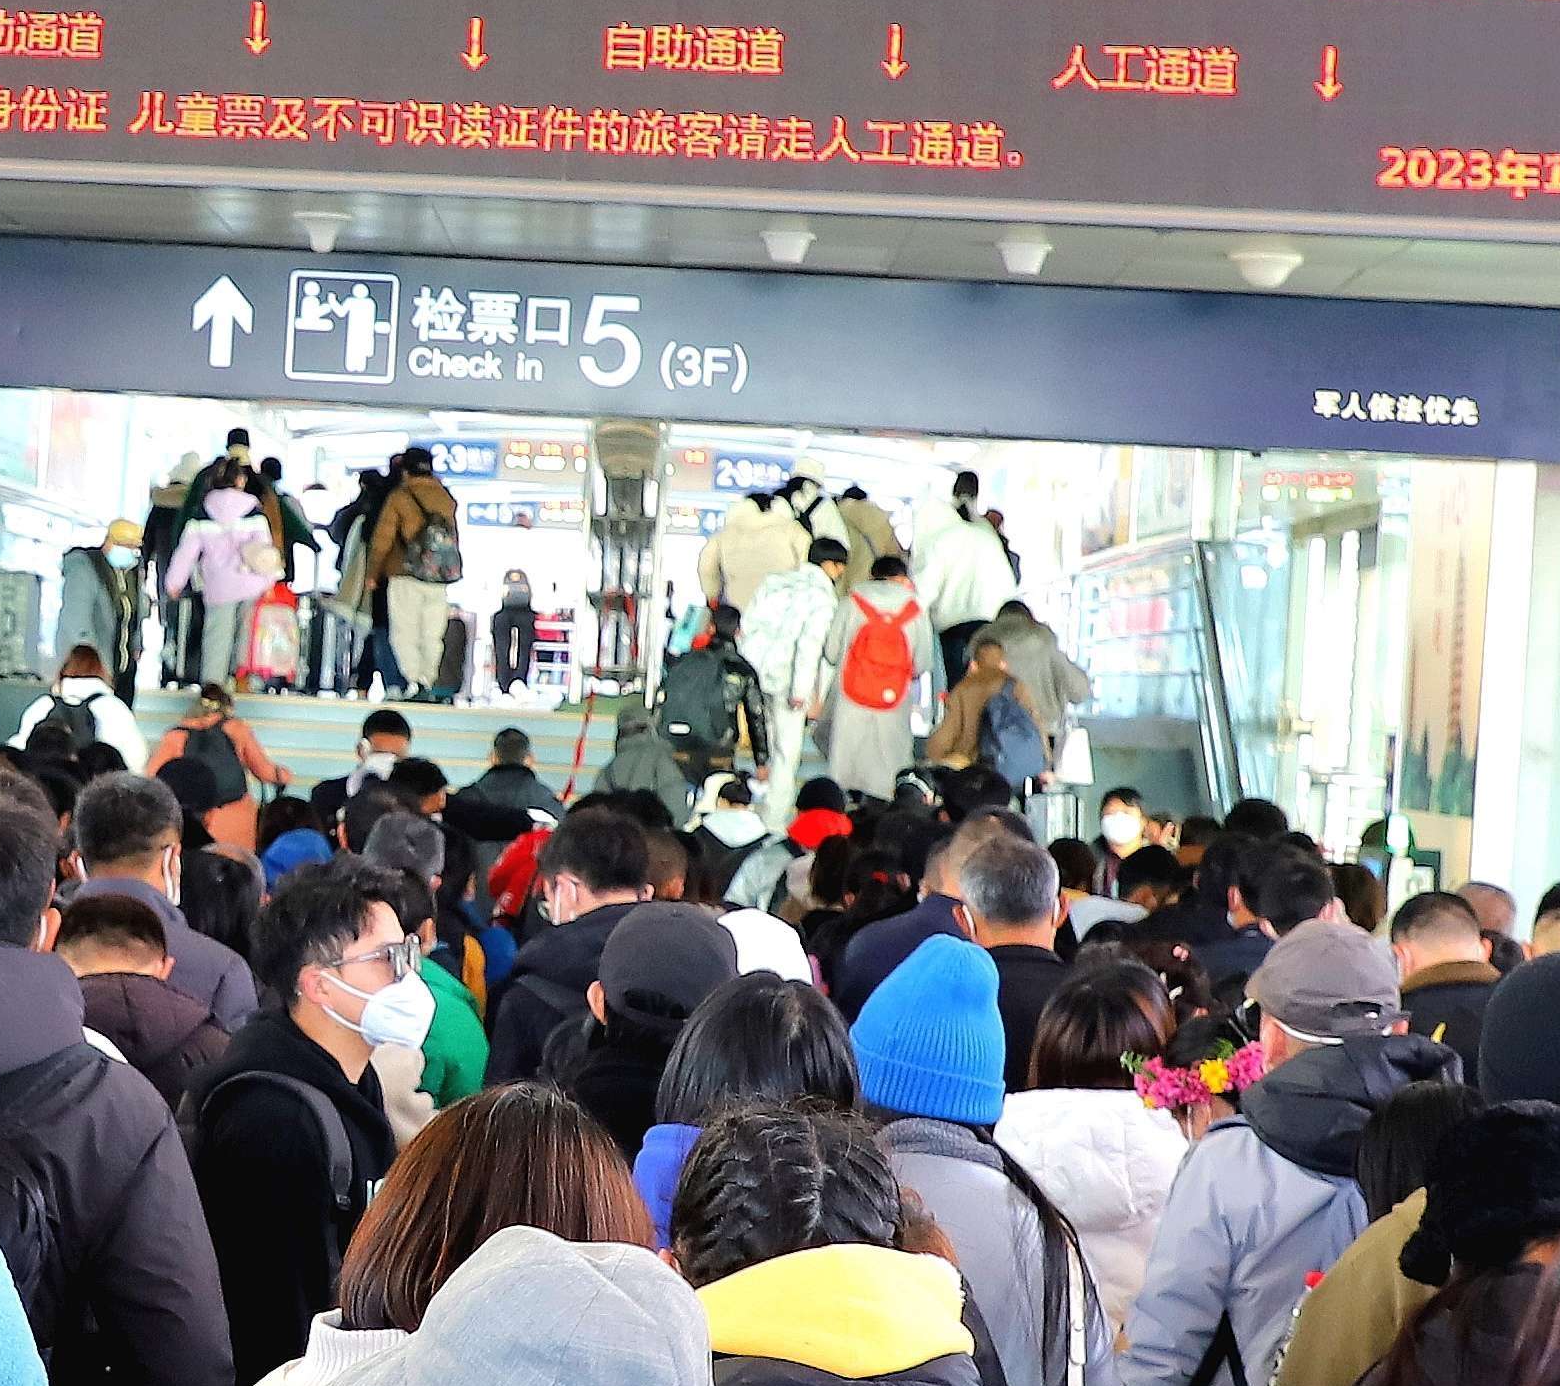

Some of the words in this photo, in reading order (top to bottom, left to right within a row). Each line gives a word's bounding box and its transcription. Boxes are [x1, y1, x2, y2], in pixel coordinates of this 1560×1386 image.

[602, 21, 785, 76] 自助通道
[1052, 45, 1239, 96] 人工通道
[407, 346, 503, 383] Check
[515, 349, 545, 383] in
[410, 284, 573, 347] 检票口
[578, 293, 642, 389] 5
[659, 341, 750, 395] (3F)
